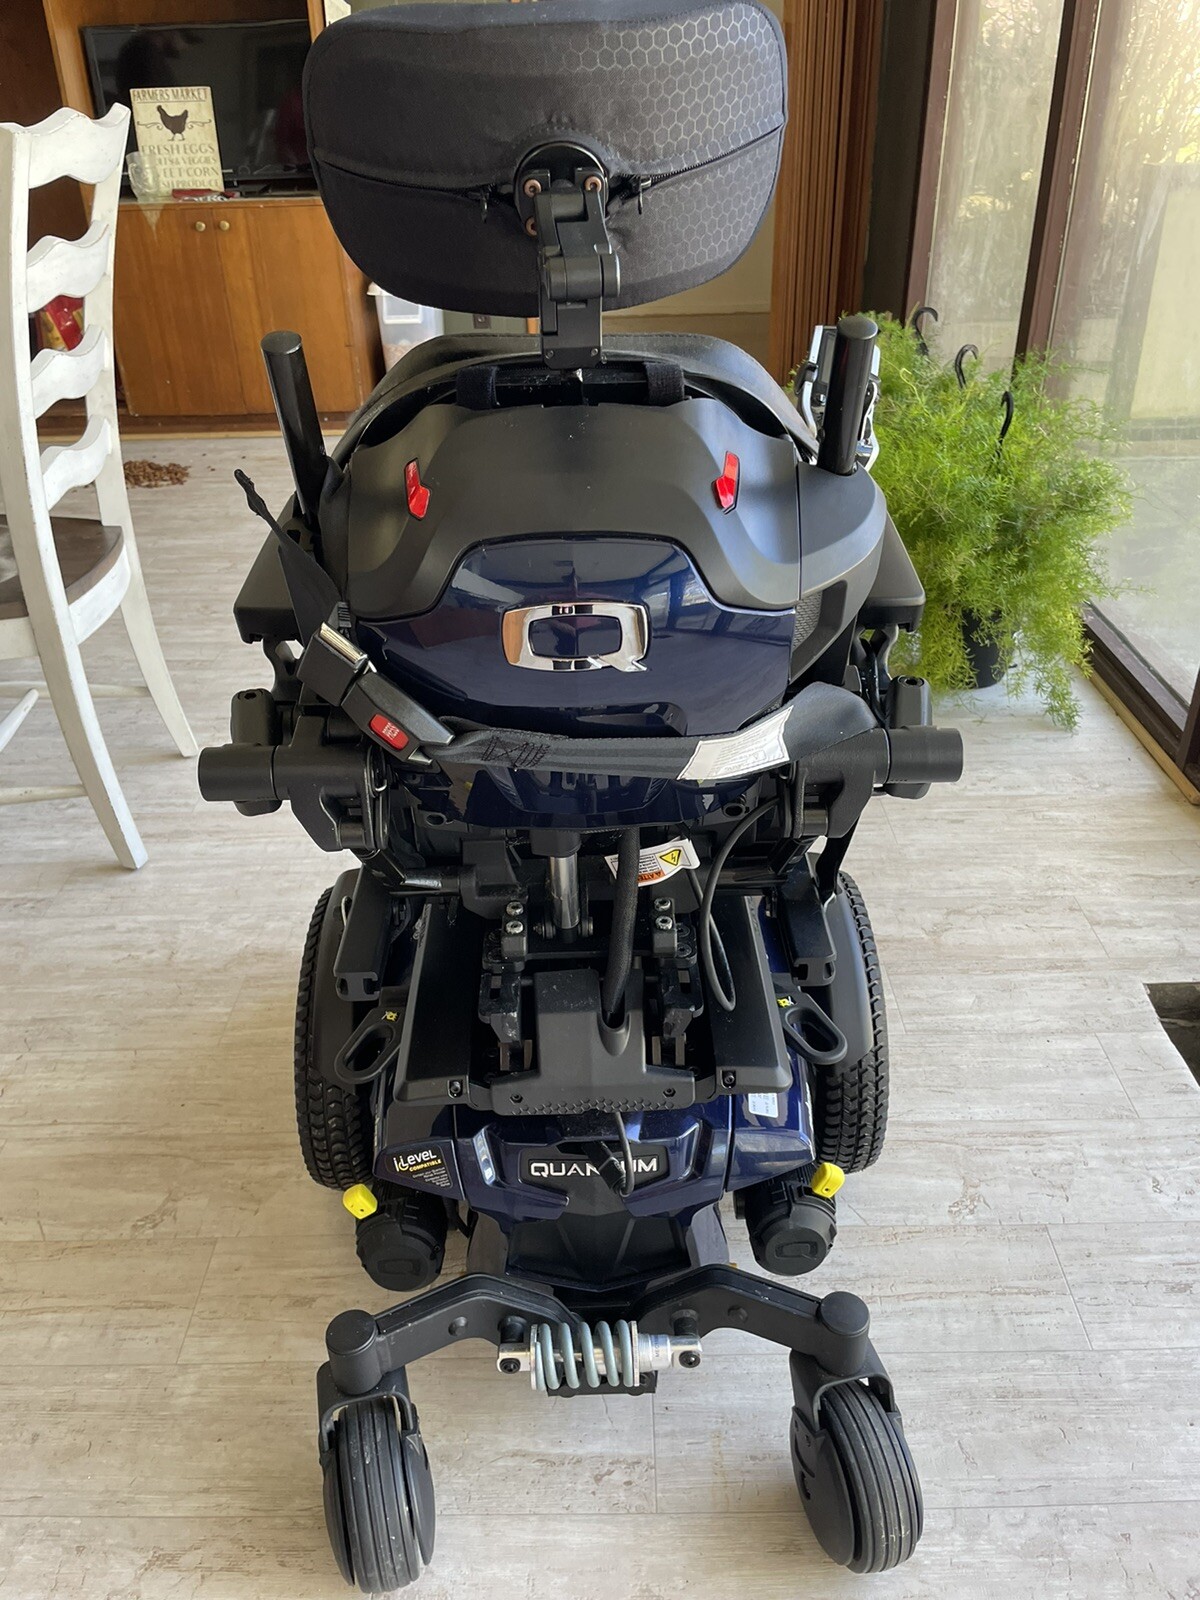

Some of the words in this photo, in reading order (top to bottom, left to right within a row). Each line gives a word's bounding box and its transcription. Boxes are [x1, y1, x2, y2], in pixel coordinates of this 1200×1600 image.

[132, 89, 170, 101] FARMERS
[171, 88, 208, 100] MARKET
[141, 144, 181, 156] FRESH
[183, 143, 215, 154] EGGS
[186, 167, 219, 178] CORN
[502, 602, 648, 672] Q
[409, 1158, 442, 1172] COMPATIBLE
[530, 1158, 657, 1178] QUANUM
